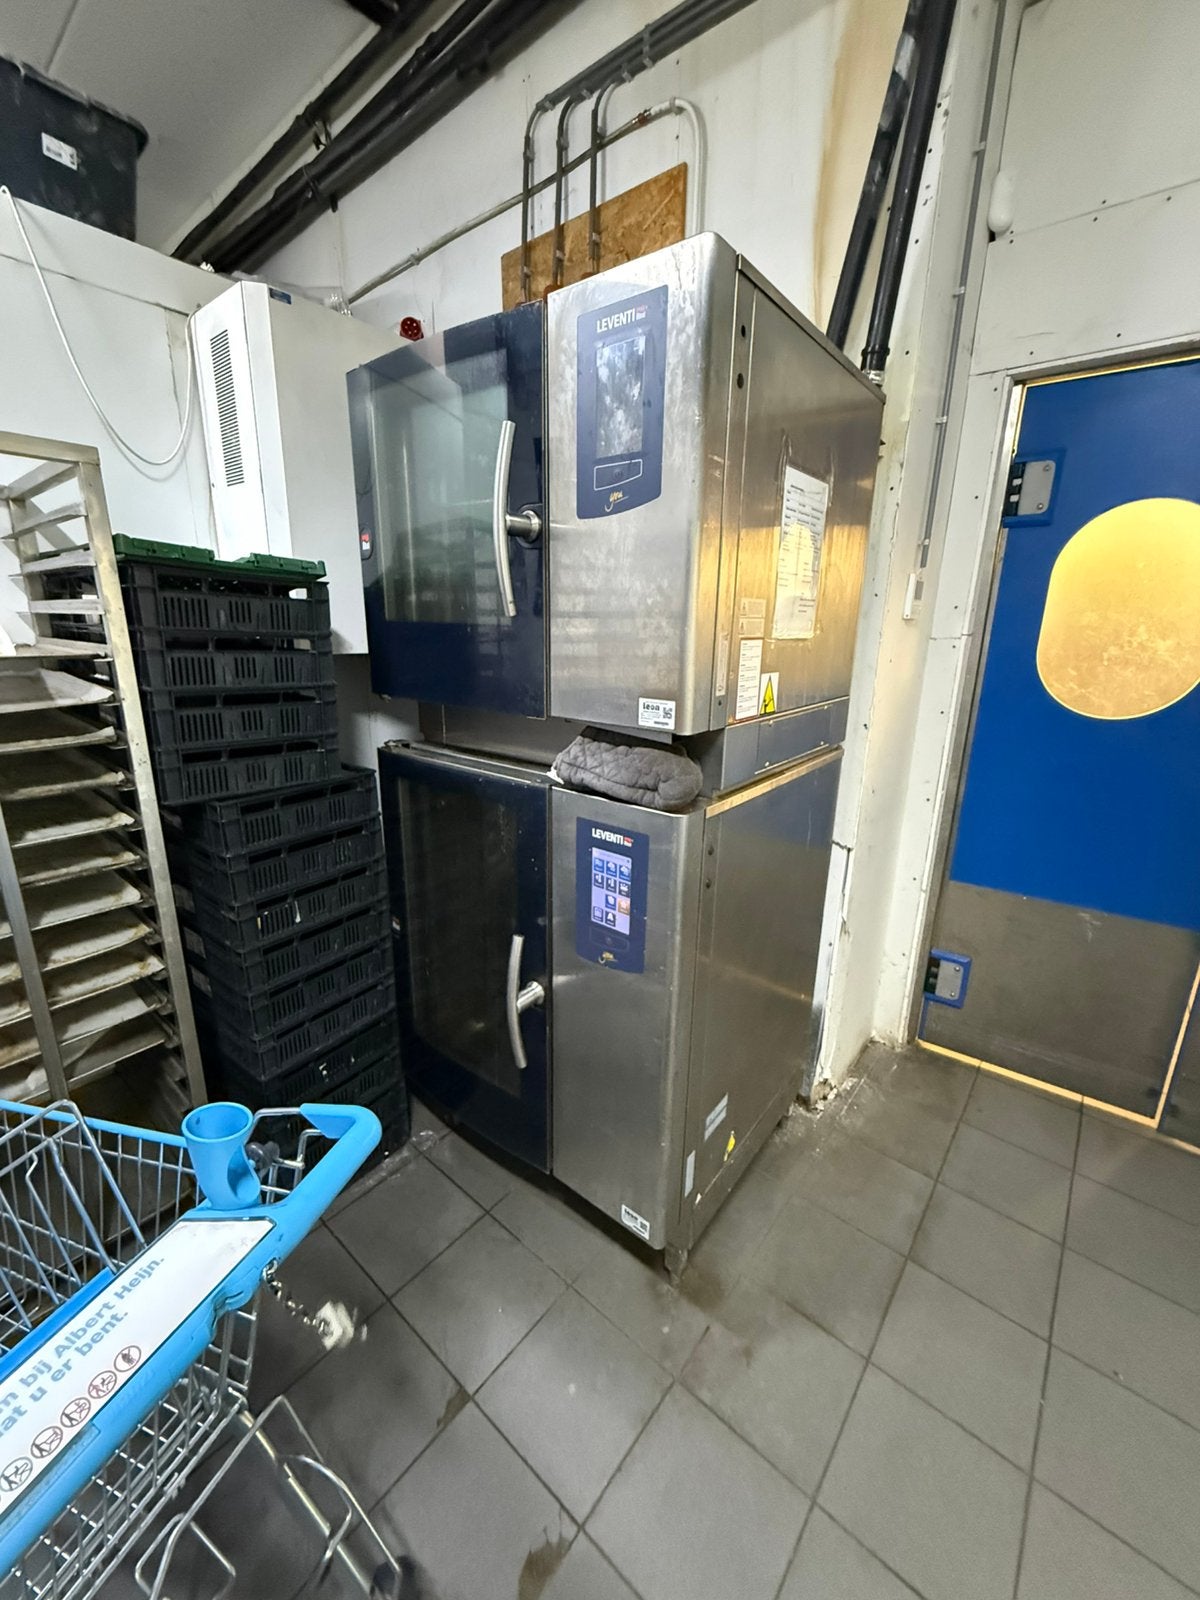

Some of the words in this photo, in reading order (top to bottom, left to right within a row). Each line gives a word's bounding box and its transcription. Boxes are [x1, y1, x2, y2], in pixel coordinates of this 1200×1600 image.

[596, 307, 636, 333] LEVENTI
[591, 828, 624, 845] LEVENTI
[19, 1359, 53, 1388] bij
[54, 1302, 116, 1359] Albert
[114, 1257, 166, 1300] Heijn.
[29, 1386, 48, 1402] u
[51, 1359, 73, 1383] er
[74, 1311, 129, 1357] bent.
